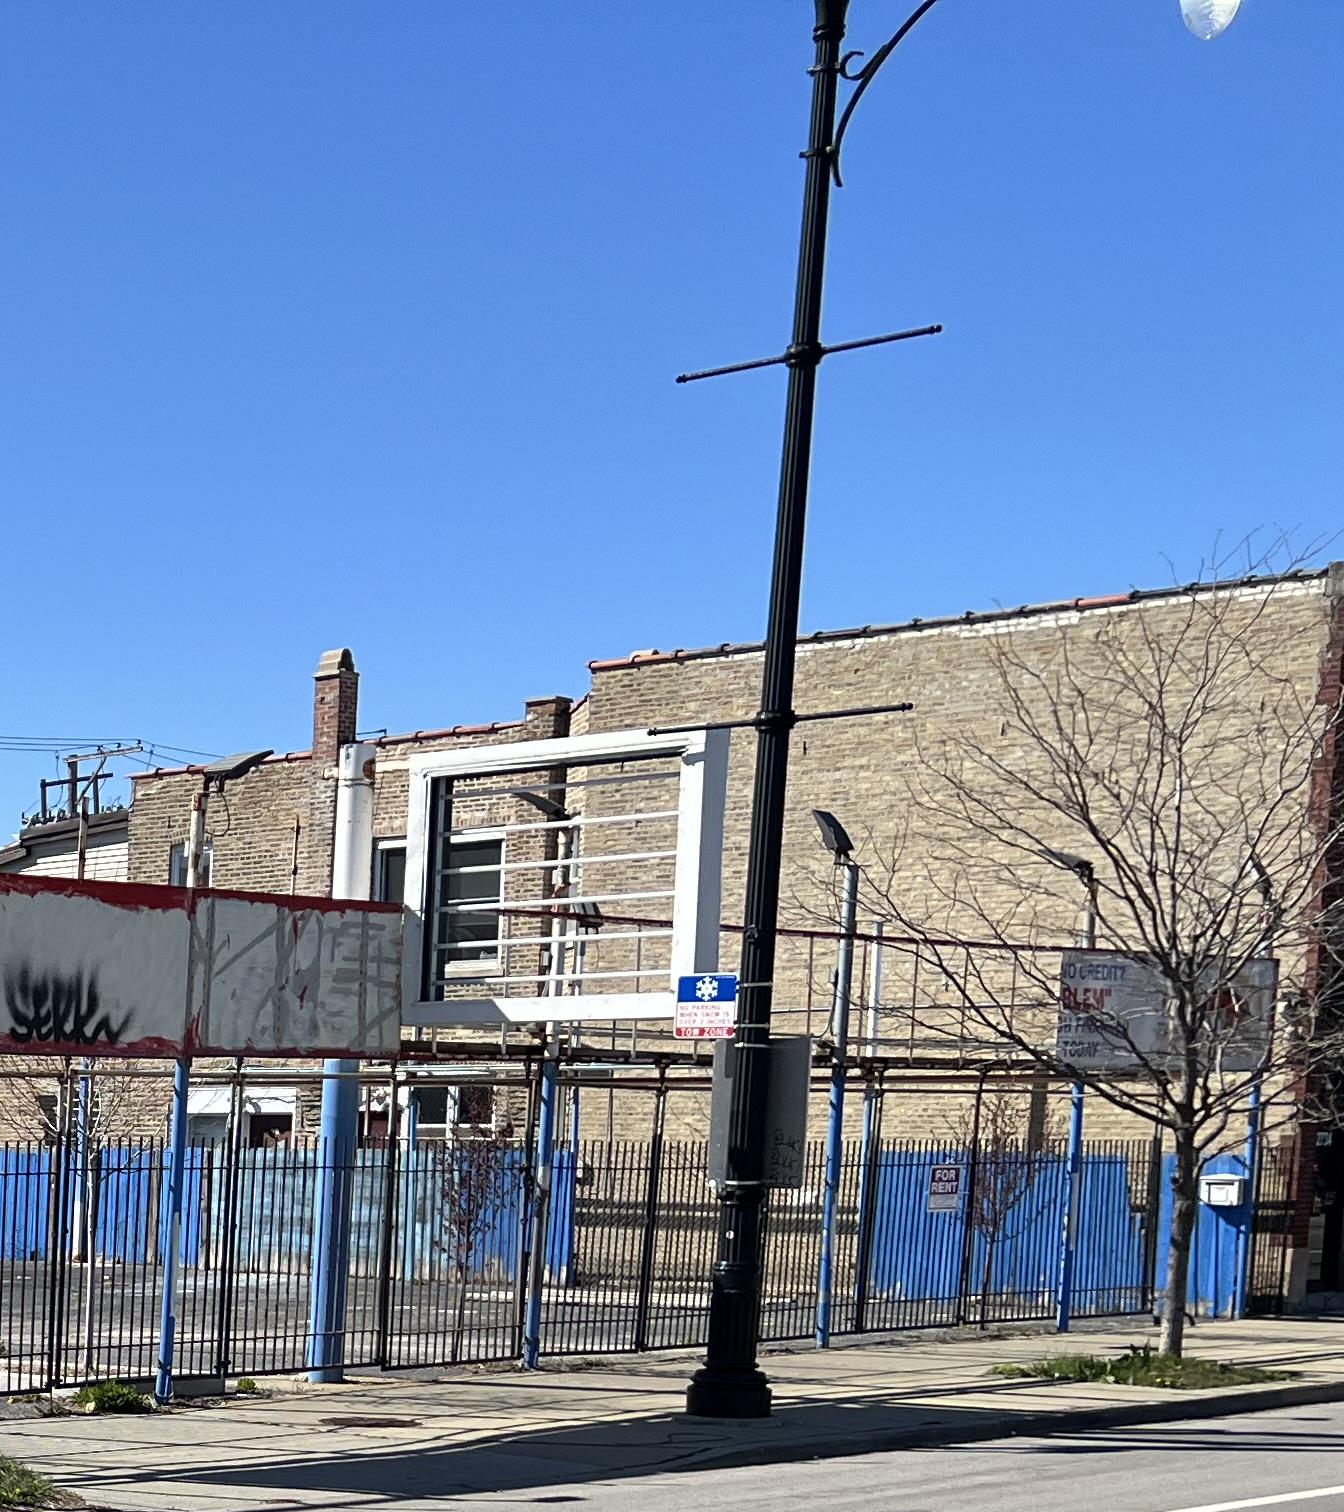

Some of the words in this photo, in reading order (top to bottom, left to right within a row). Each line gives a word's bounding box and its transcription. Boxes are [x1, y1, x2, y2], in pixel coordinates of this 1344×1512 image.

[681, 1027, 700, 1037] TOW
[703, 1027, 728, 1036] ZONE
[934, 1169, 956, 1181] FOR
[931, 1181, 958, 1193] RENT
